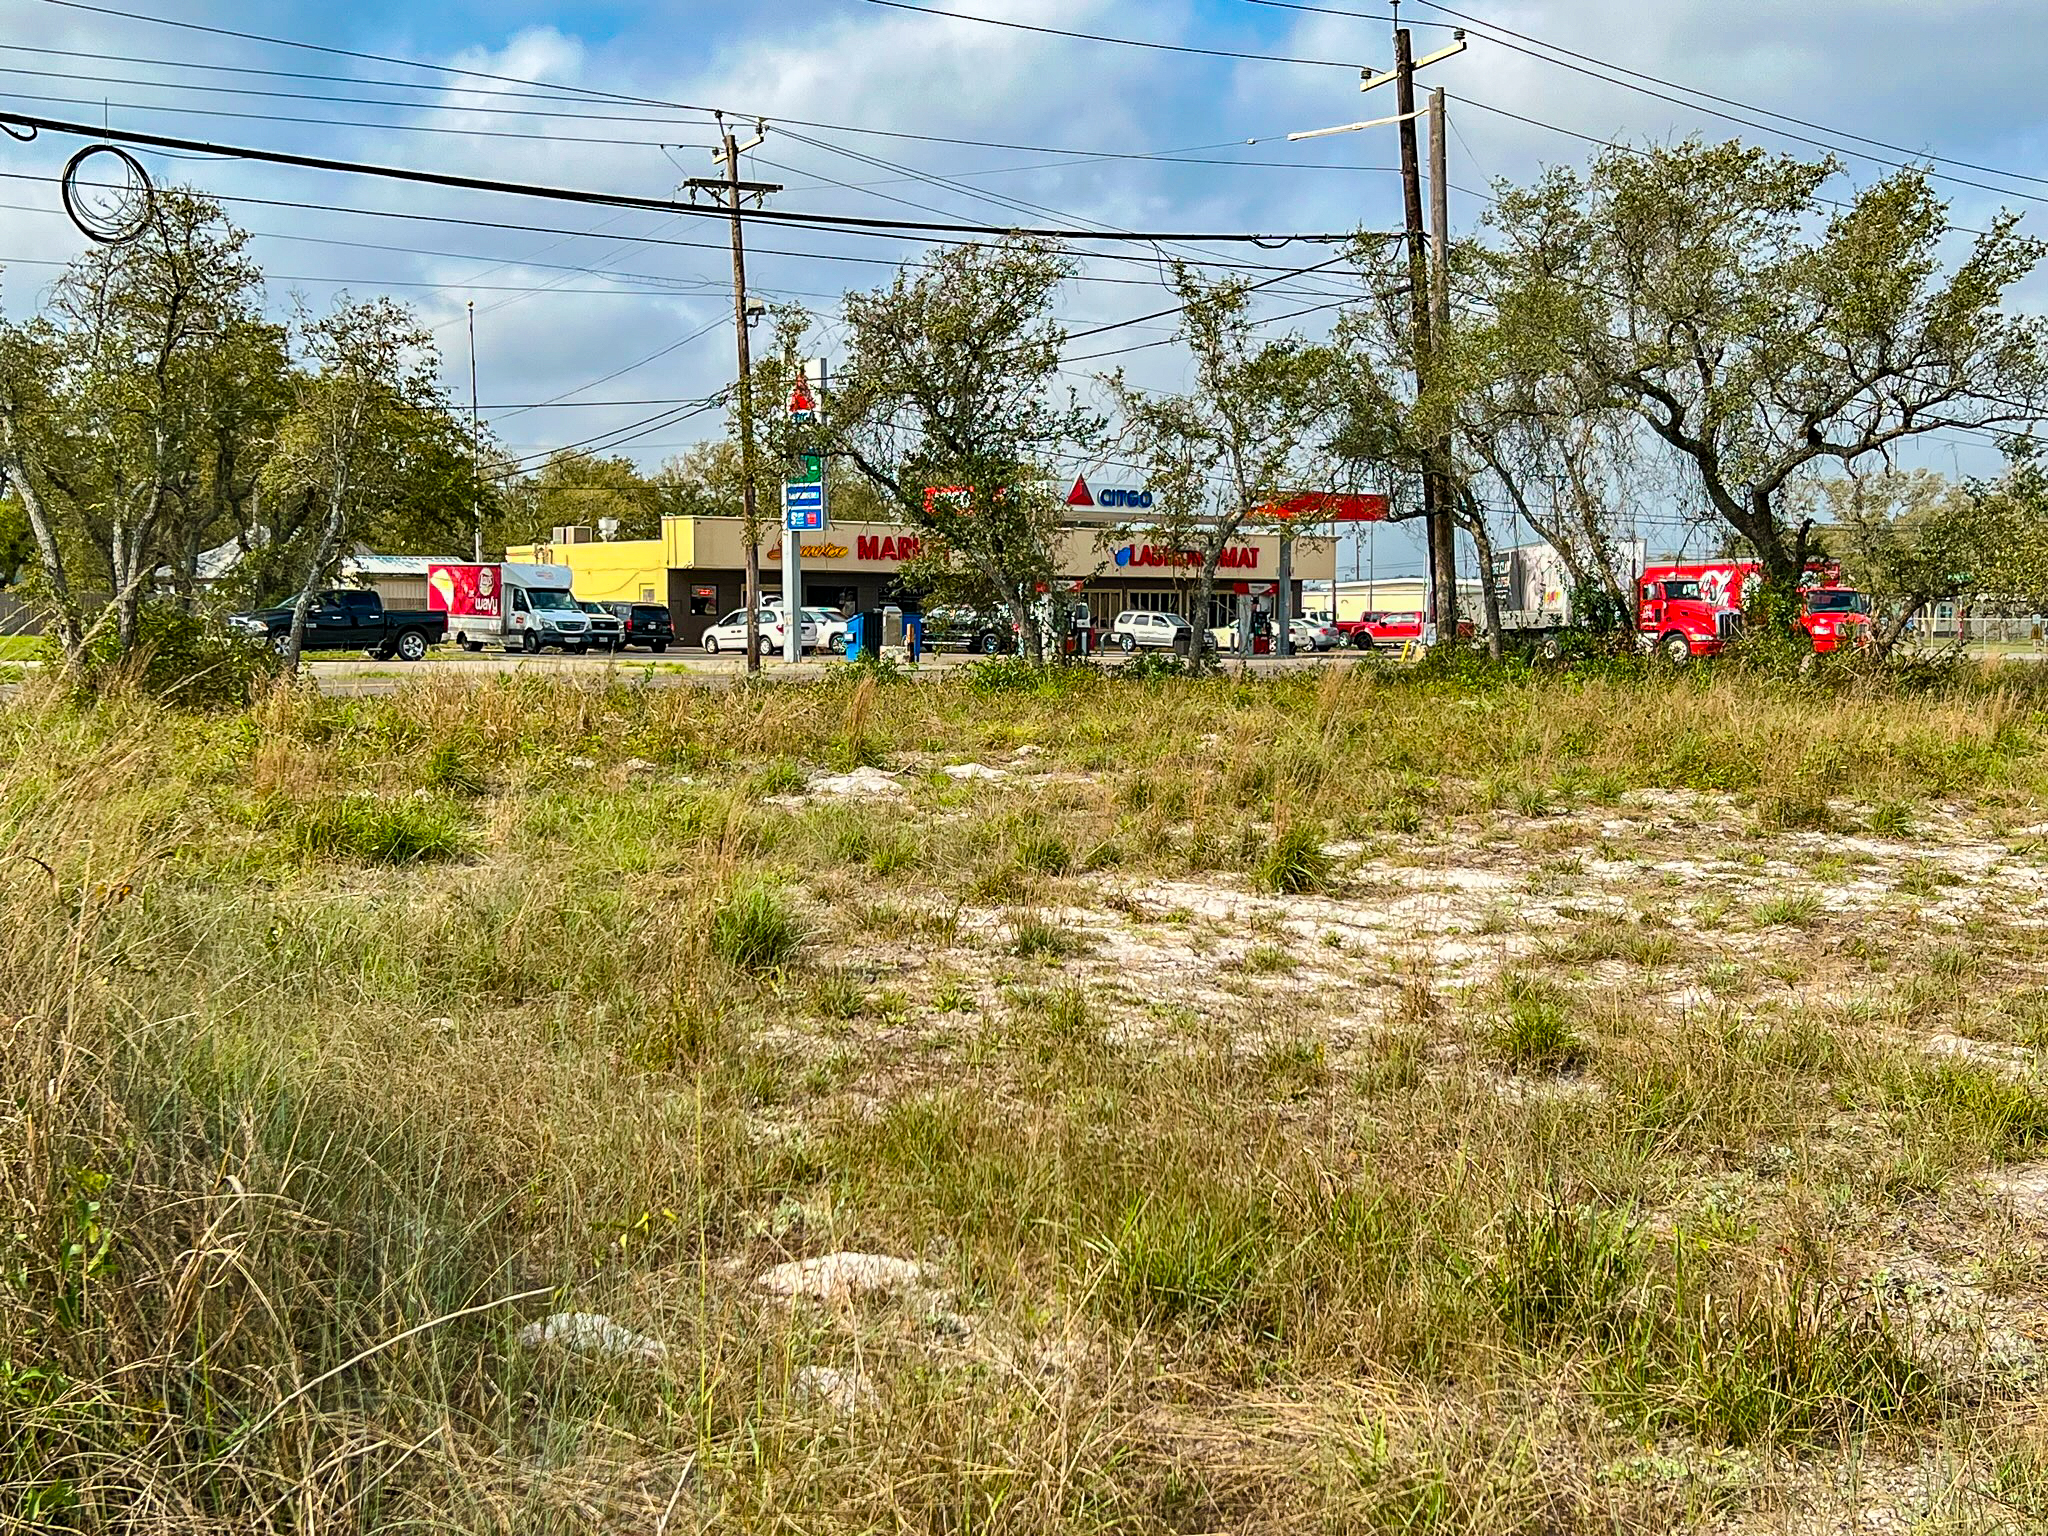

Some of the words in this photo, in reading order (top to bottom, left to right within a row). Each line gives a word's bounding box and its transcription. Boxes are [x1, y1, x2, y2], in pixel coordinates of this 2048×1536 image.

[1099, 489, 1153, 508] CITGO
[767, 538, 849, 560] nrise
[858, 536, 950, 560] MAR
[1129, 543, 1260, 568] LAURMAT
